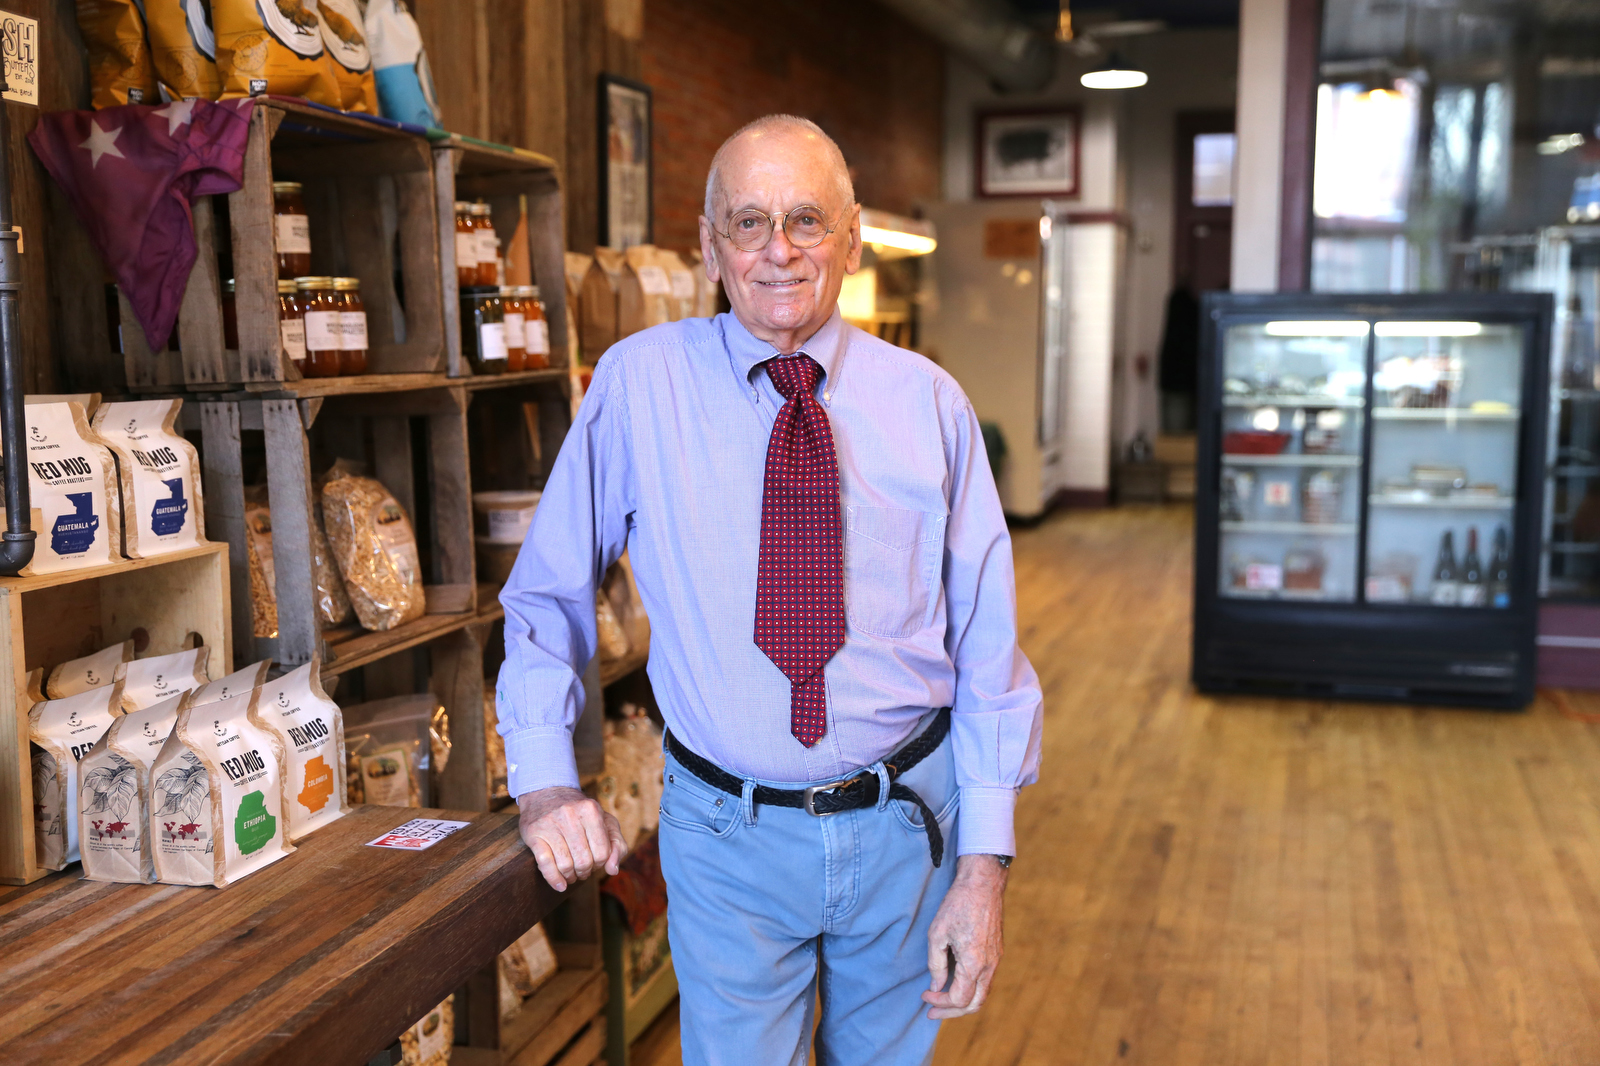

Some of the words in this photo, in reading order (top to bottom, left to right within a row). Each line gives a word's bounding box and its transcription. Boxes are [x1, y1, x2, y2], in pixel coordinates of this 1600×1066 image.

[30, 462, 62, 480] RED
[57, 456, 92, 477] MUG
[146, 446, 178, 468] MUG
[156, 505, 181, 515] GUATEMALA
[57, 522, 89, 532] GUATEMALA
[287, 727, 308, 747] RED
[300, 718, 329, 742] MUG
[220, 757, 245, 781] RED
[240, 749, 265, 774] MUG
[243, 814, 266, 829] ETHIOPIA
